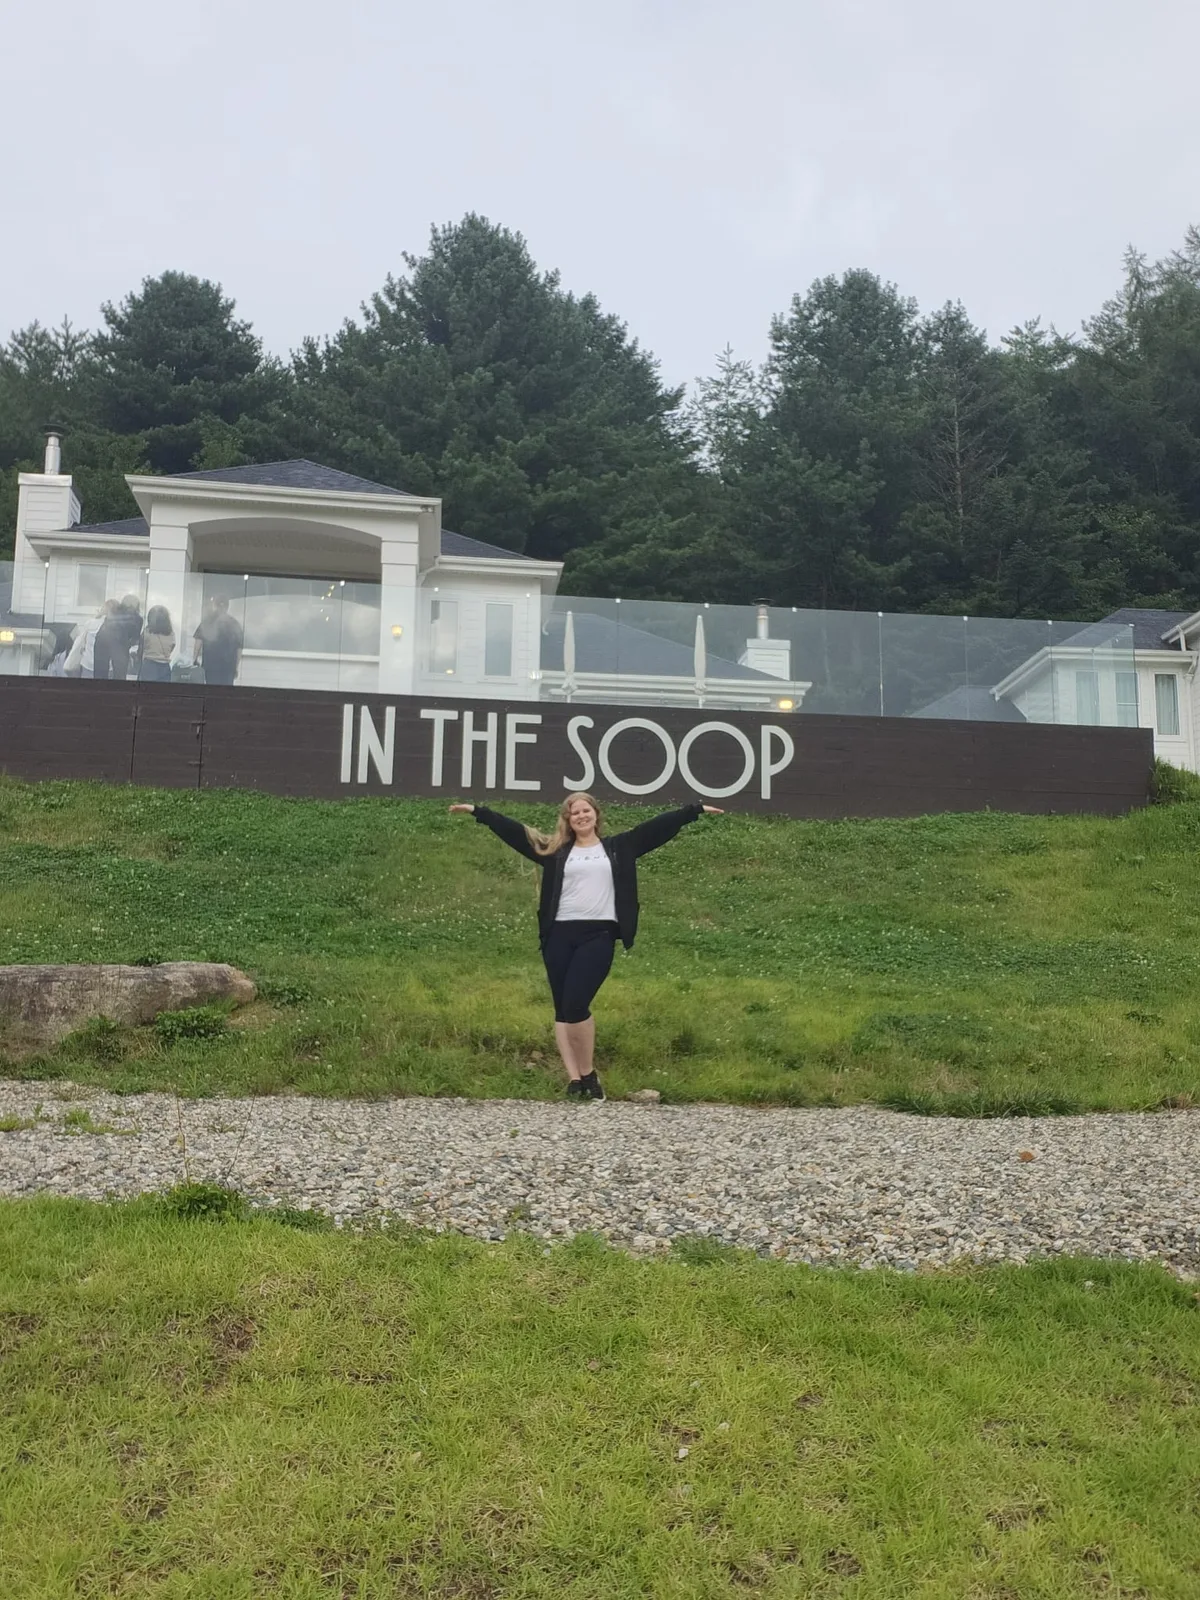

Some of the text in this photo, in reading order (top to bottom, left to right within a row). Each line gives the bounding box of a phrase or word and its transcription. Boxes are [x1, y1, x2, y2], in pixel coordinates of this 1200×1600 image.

[340, 703, 795, 800] IN THE SOOP
